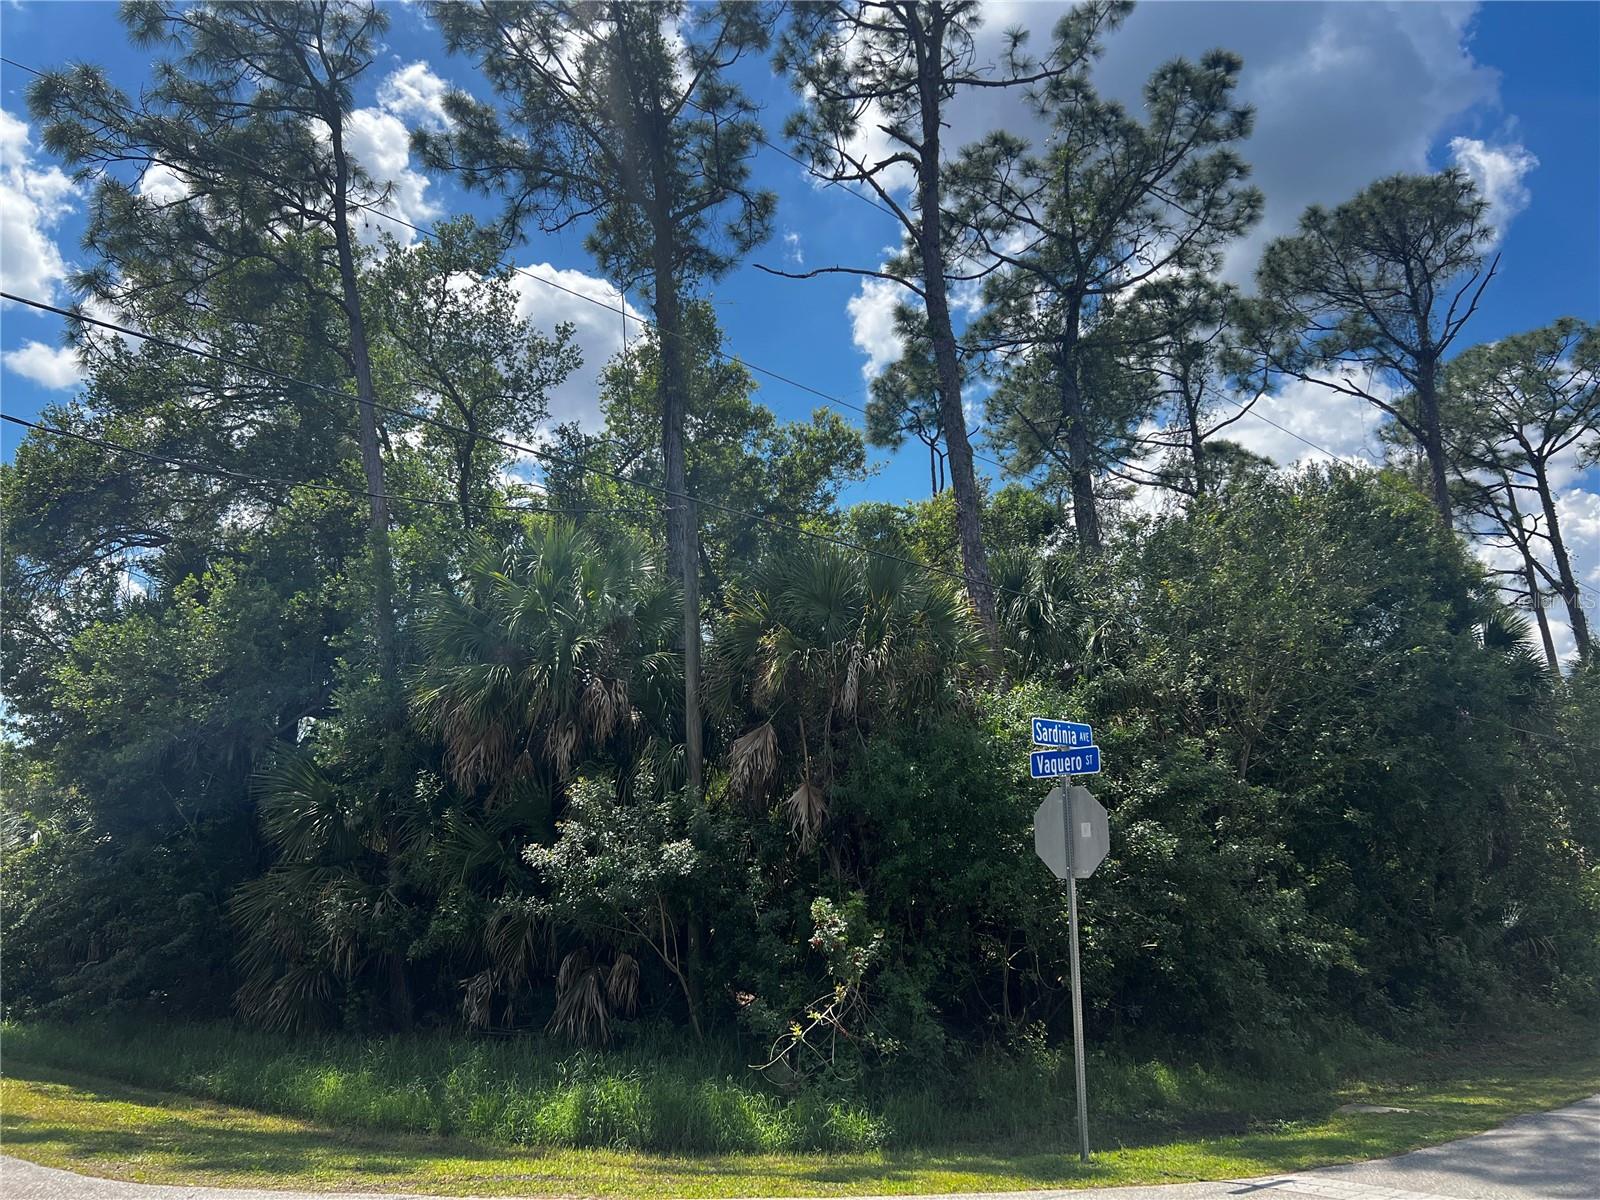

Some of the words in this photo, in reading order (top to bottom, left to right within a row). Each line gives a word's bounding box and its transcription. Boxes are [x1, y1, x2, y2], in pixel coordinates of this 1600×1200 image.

[1036, 721, 1077, 745] Sardinia
[1080, 731, 1090, 743] AVE
[1037, 754, 1082, 776] Vaquero
[1085, 754, 1093, 766] ST
